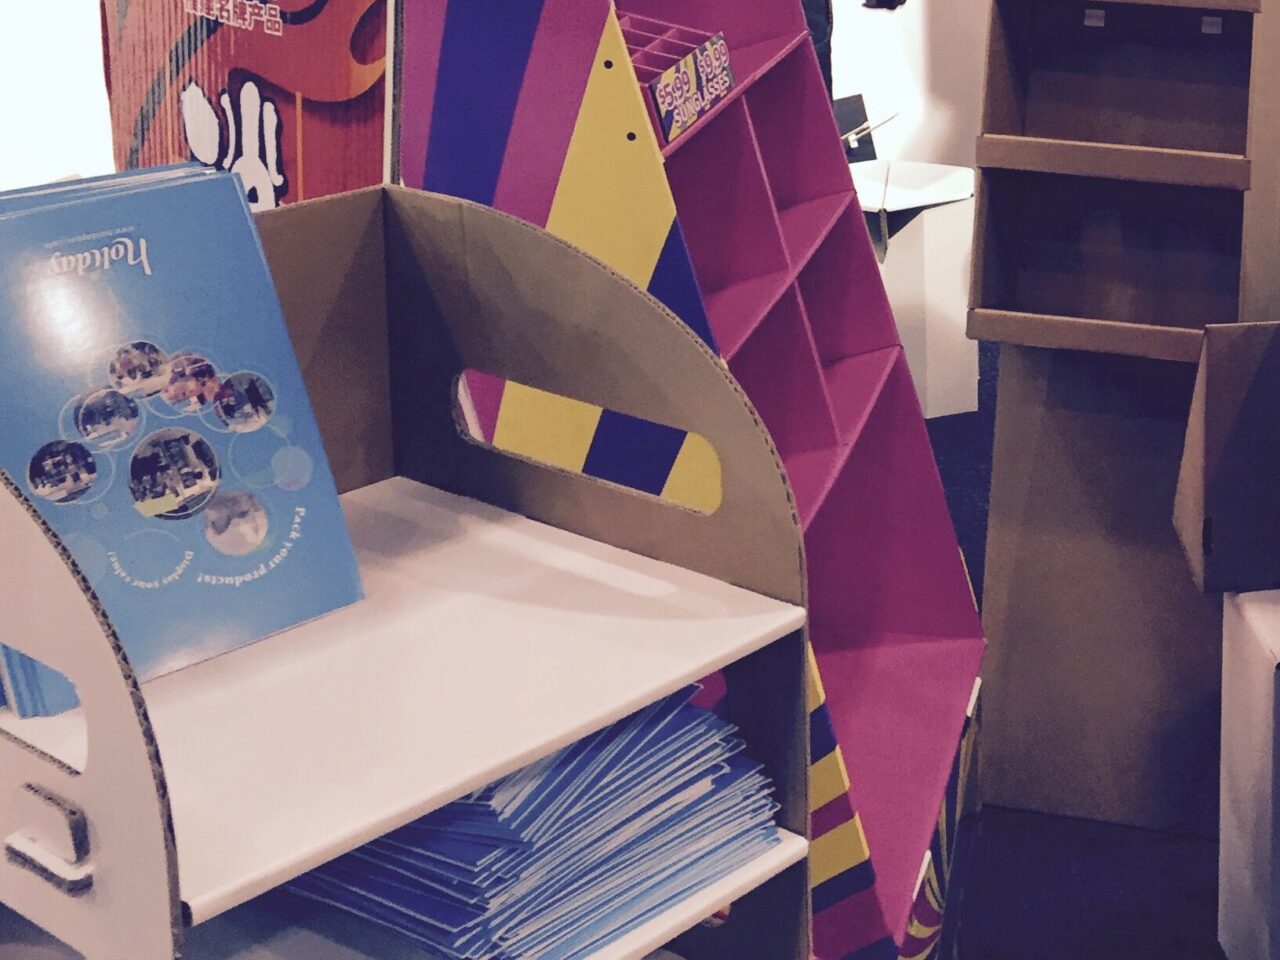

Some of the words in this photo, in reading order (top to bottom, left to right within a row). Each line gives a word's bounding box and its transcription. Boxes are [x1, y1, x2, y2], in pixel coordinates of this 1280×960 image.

[697, 39, 730, 80] $9.99
[656, 69, 691, 111] $5.99
[673, 70, 730, 129] SUNGLASSES
[50, 237, 152, 275] holiday
[196, 562, 268, 588] products!
